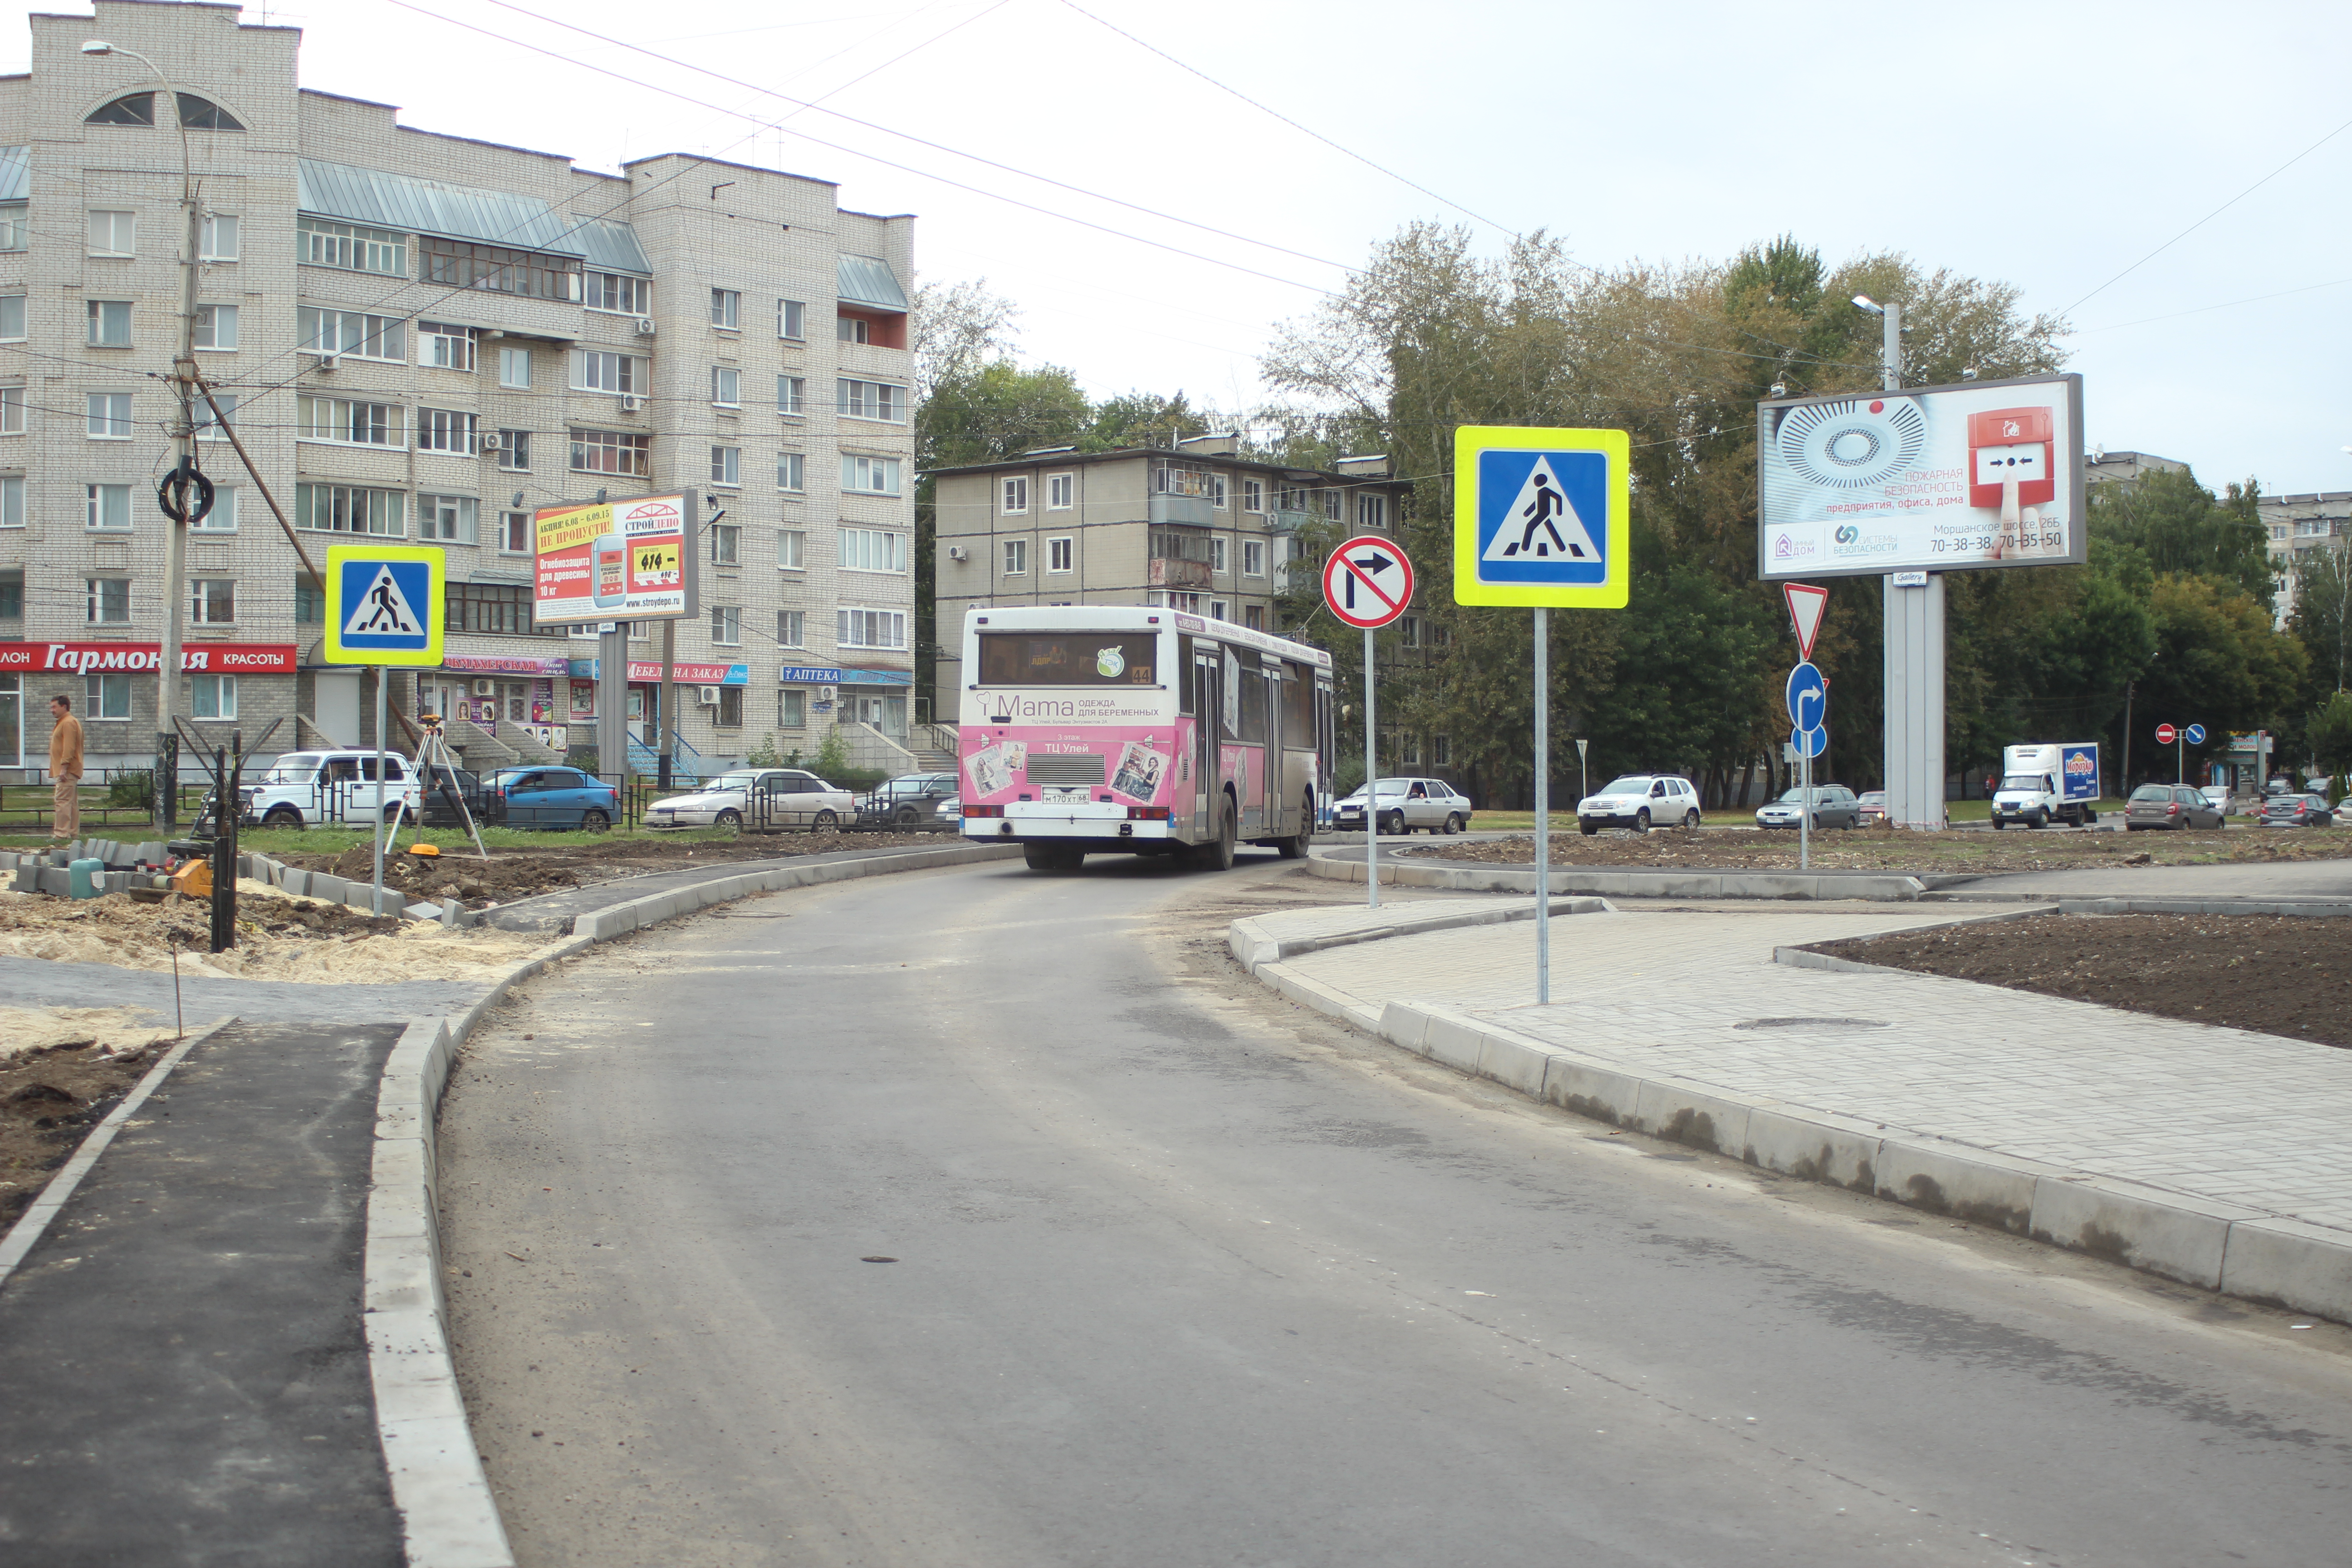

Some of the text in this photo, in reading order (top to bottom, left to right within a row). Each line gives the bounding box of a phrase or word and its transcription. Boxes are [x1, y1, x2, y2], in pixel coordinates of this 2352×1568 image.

[1906, 468, 1963, 482] ПОЖАРНАЯ
[1885, 481, 1963, 496] БЕЗОПАСНОСТЬ
[1827, 496, 1964, 514] предприятия, офиса, дома
[540, 520, 564, 534] АКЦИЯ!
[565, 517, 578, 528] 6.08
[586, 510, 609, 522] 6.09.15
[625, 518, 679, 531] СТРОЙДЕПО
[1934, 517, 2060, 536] Моршанское шоссе, 26Б
[540, 521, 610, 548] НЕ ПРОПУСТИ!
[1858, 534, 1897, 544] СИСТЕМЫ
[1833, 543, 1897, 554] БЕЗОПАСНОСТИ
[1931, 532, 2061, 552] 70-38-38, 70-35-50
[1793, 546, 1814, 557] ДОМ
[540, 557, 590, 570] Огнебиозащита
[642, 553, 662, 571] 414
[540, 569, 590, 583] для древесины
[1897, 573, 1922, 583] Gallery
[540, 585, 557, 596] 10 кг
[626, 597, 680, 608] www.stroydepo.ru
[0, 652, 30, 663] ЛОН
[224, 654, 284, 665] КРАСОТЫ
[1031, 657, 1050, 666] ЛДПР
[1098, 650, 1105, 660] Я
[444, 657, 537, 671] ИКМАХЕРСКАЯ
[543, 659, 563, 668] Ваш
[1104, 658, 1118, 668] ТЭК
[627, 663, 725, 679] МЕБЕЛ НА ЗАКАЗ
[793, 669, 838, 681] АПТЕКА
[1133, 669, 1150, 682] 44
[998, 695, 1074, 716] Mama
[1078, 699, 1116, 708] ОДЕЖДА
[1078, 709, 1096, 718] ДЛЯ
[1045, 744, 1089, 754] ТЦ Улей
[2067, 759, 2092, 774] Морозко
